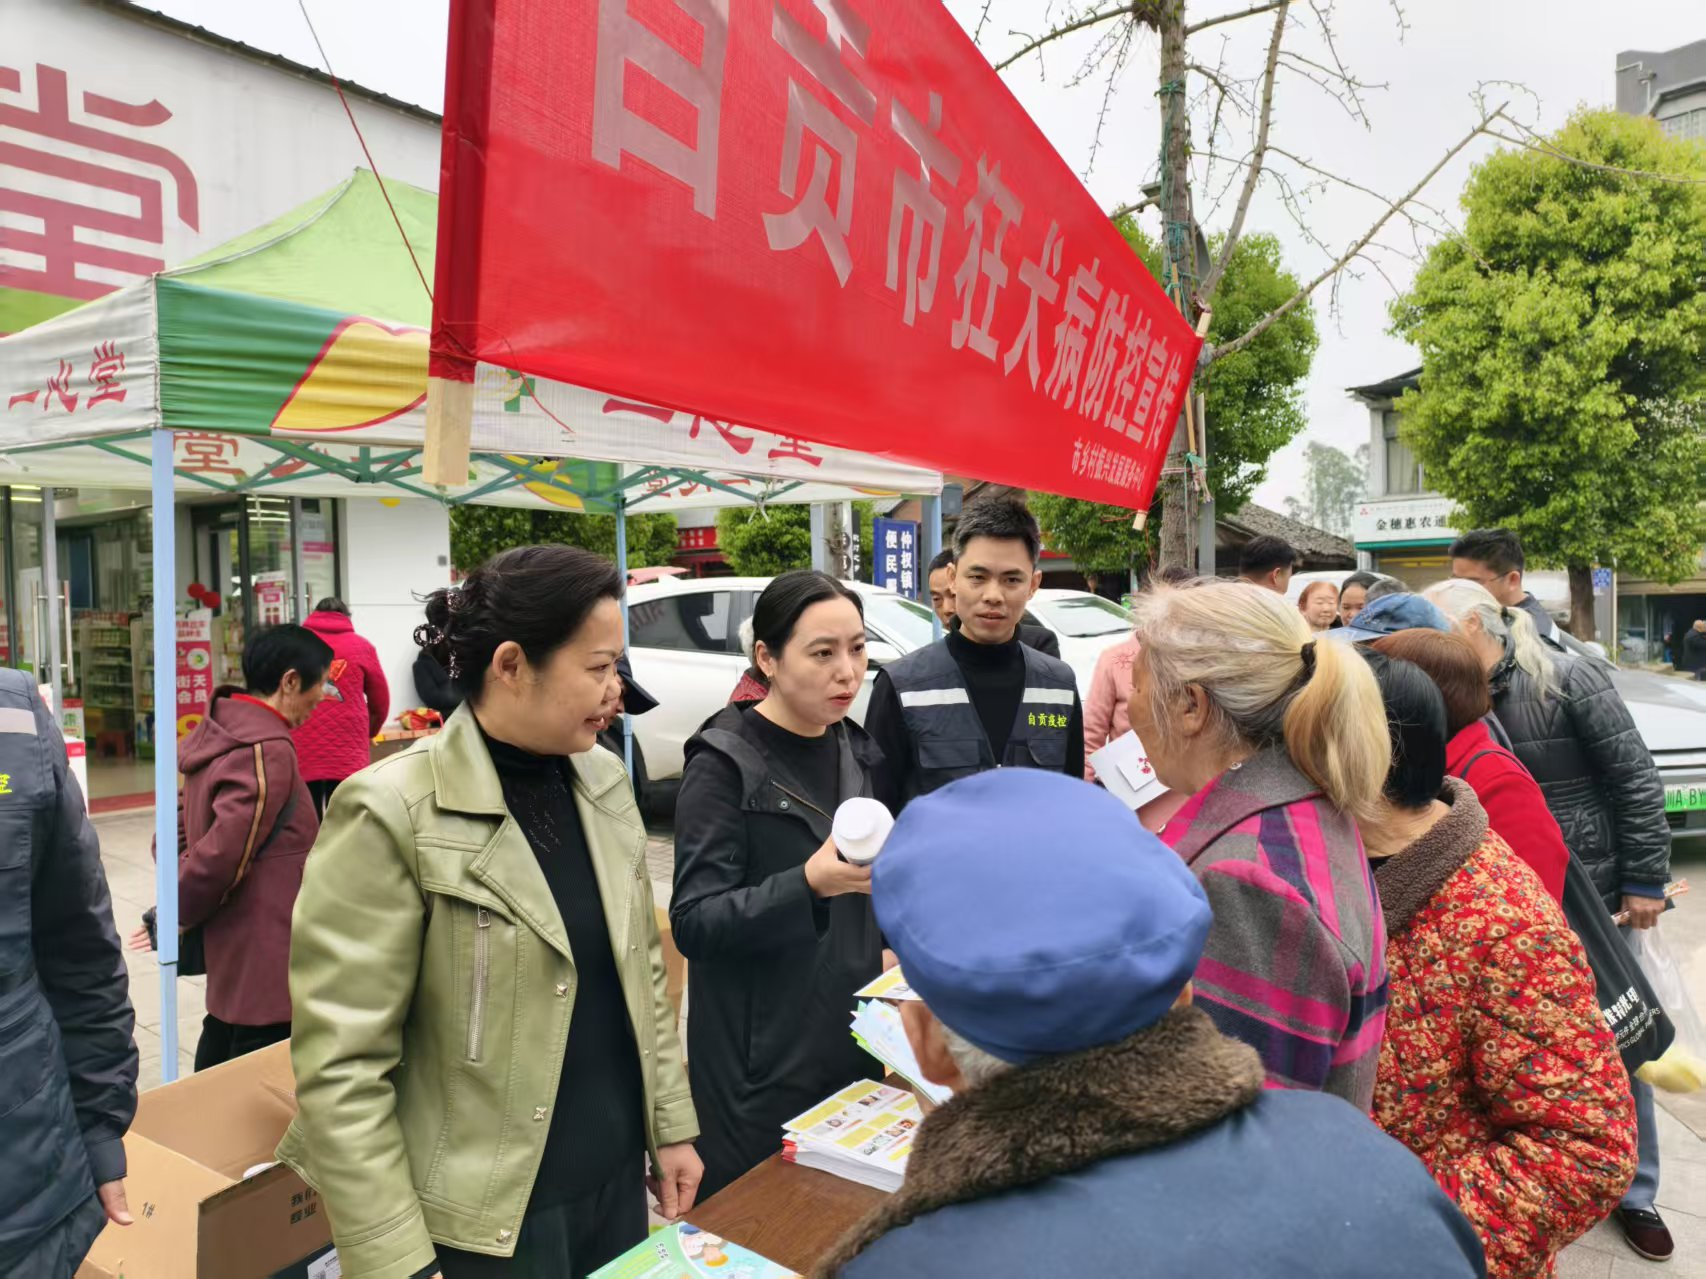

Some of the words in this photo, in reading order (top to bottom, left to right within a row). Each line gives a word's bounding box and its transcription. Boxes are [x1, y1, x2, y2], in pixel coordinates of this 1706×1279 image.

[592, 0, 1182, 449] 自贡市狂犬病防控宣传
[8, 340, 127, 414] 一心堂
[1028, 711, 1067, 728] 自贡疫控
